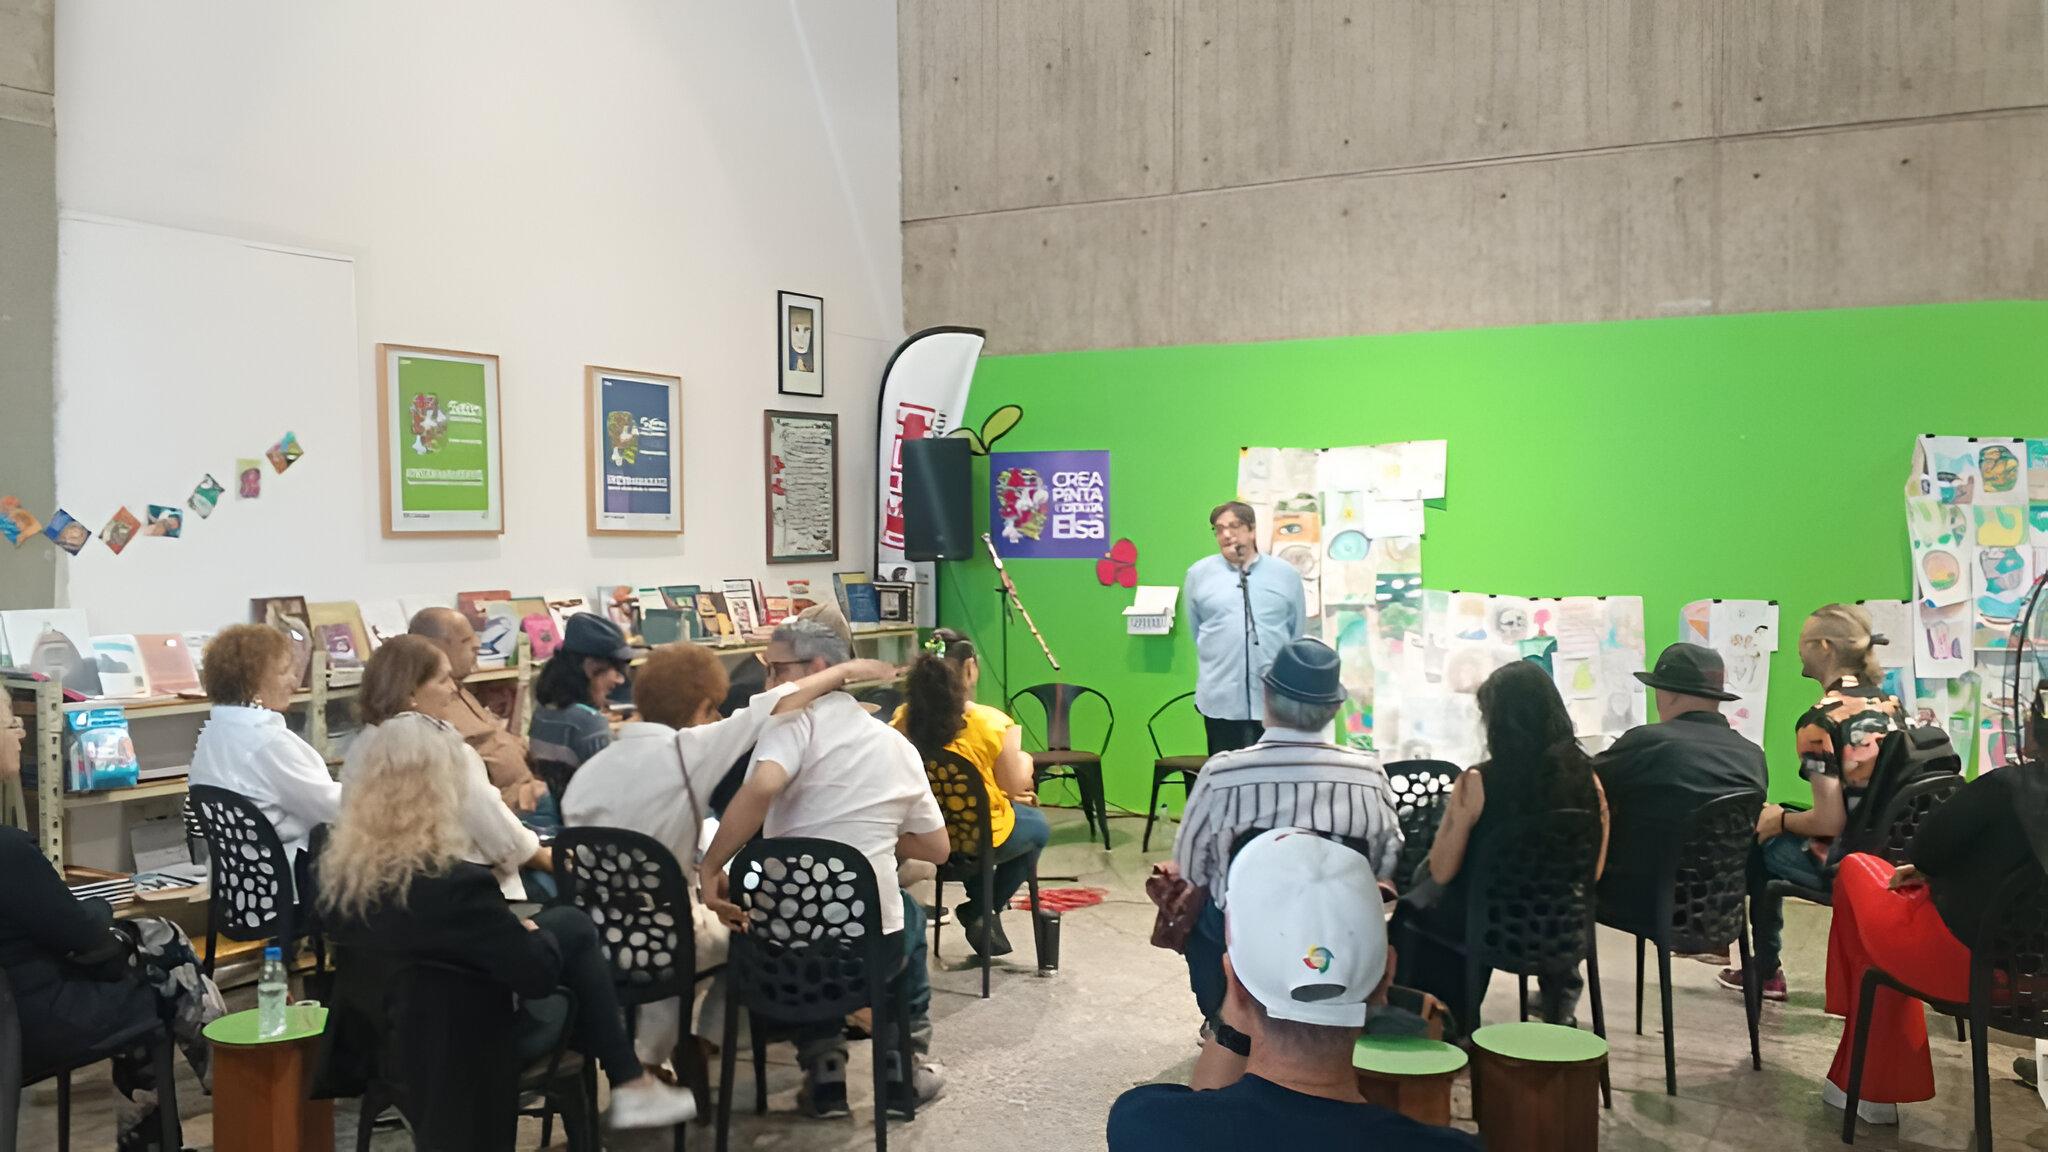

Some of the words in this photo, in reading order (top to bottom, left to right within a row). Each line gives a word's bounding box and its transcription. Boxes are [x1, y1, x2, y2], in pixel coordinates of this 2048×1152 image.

[1052, 471, 1104, 487] CREA
[1052, 488, 1104, 502] PINTA
[1052, 514, 1105, 539] Elsa
